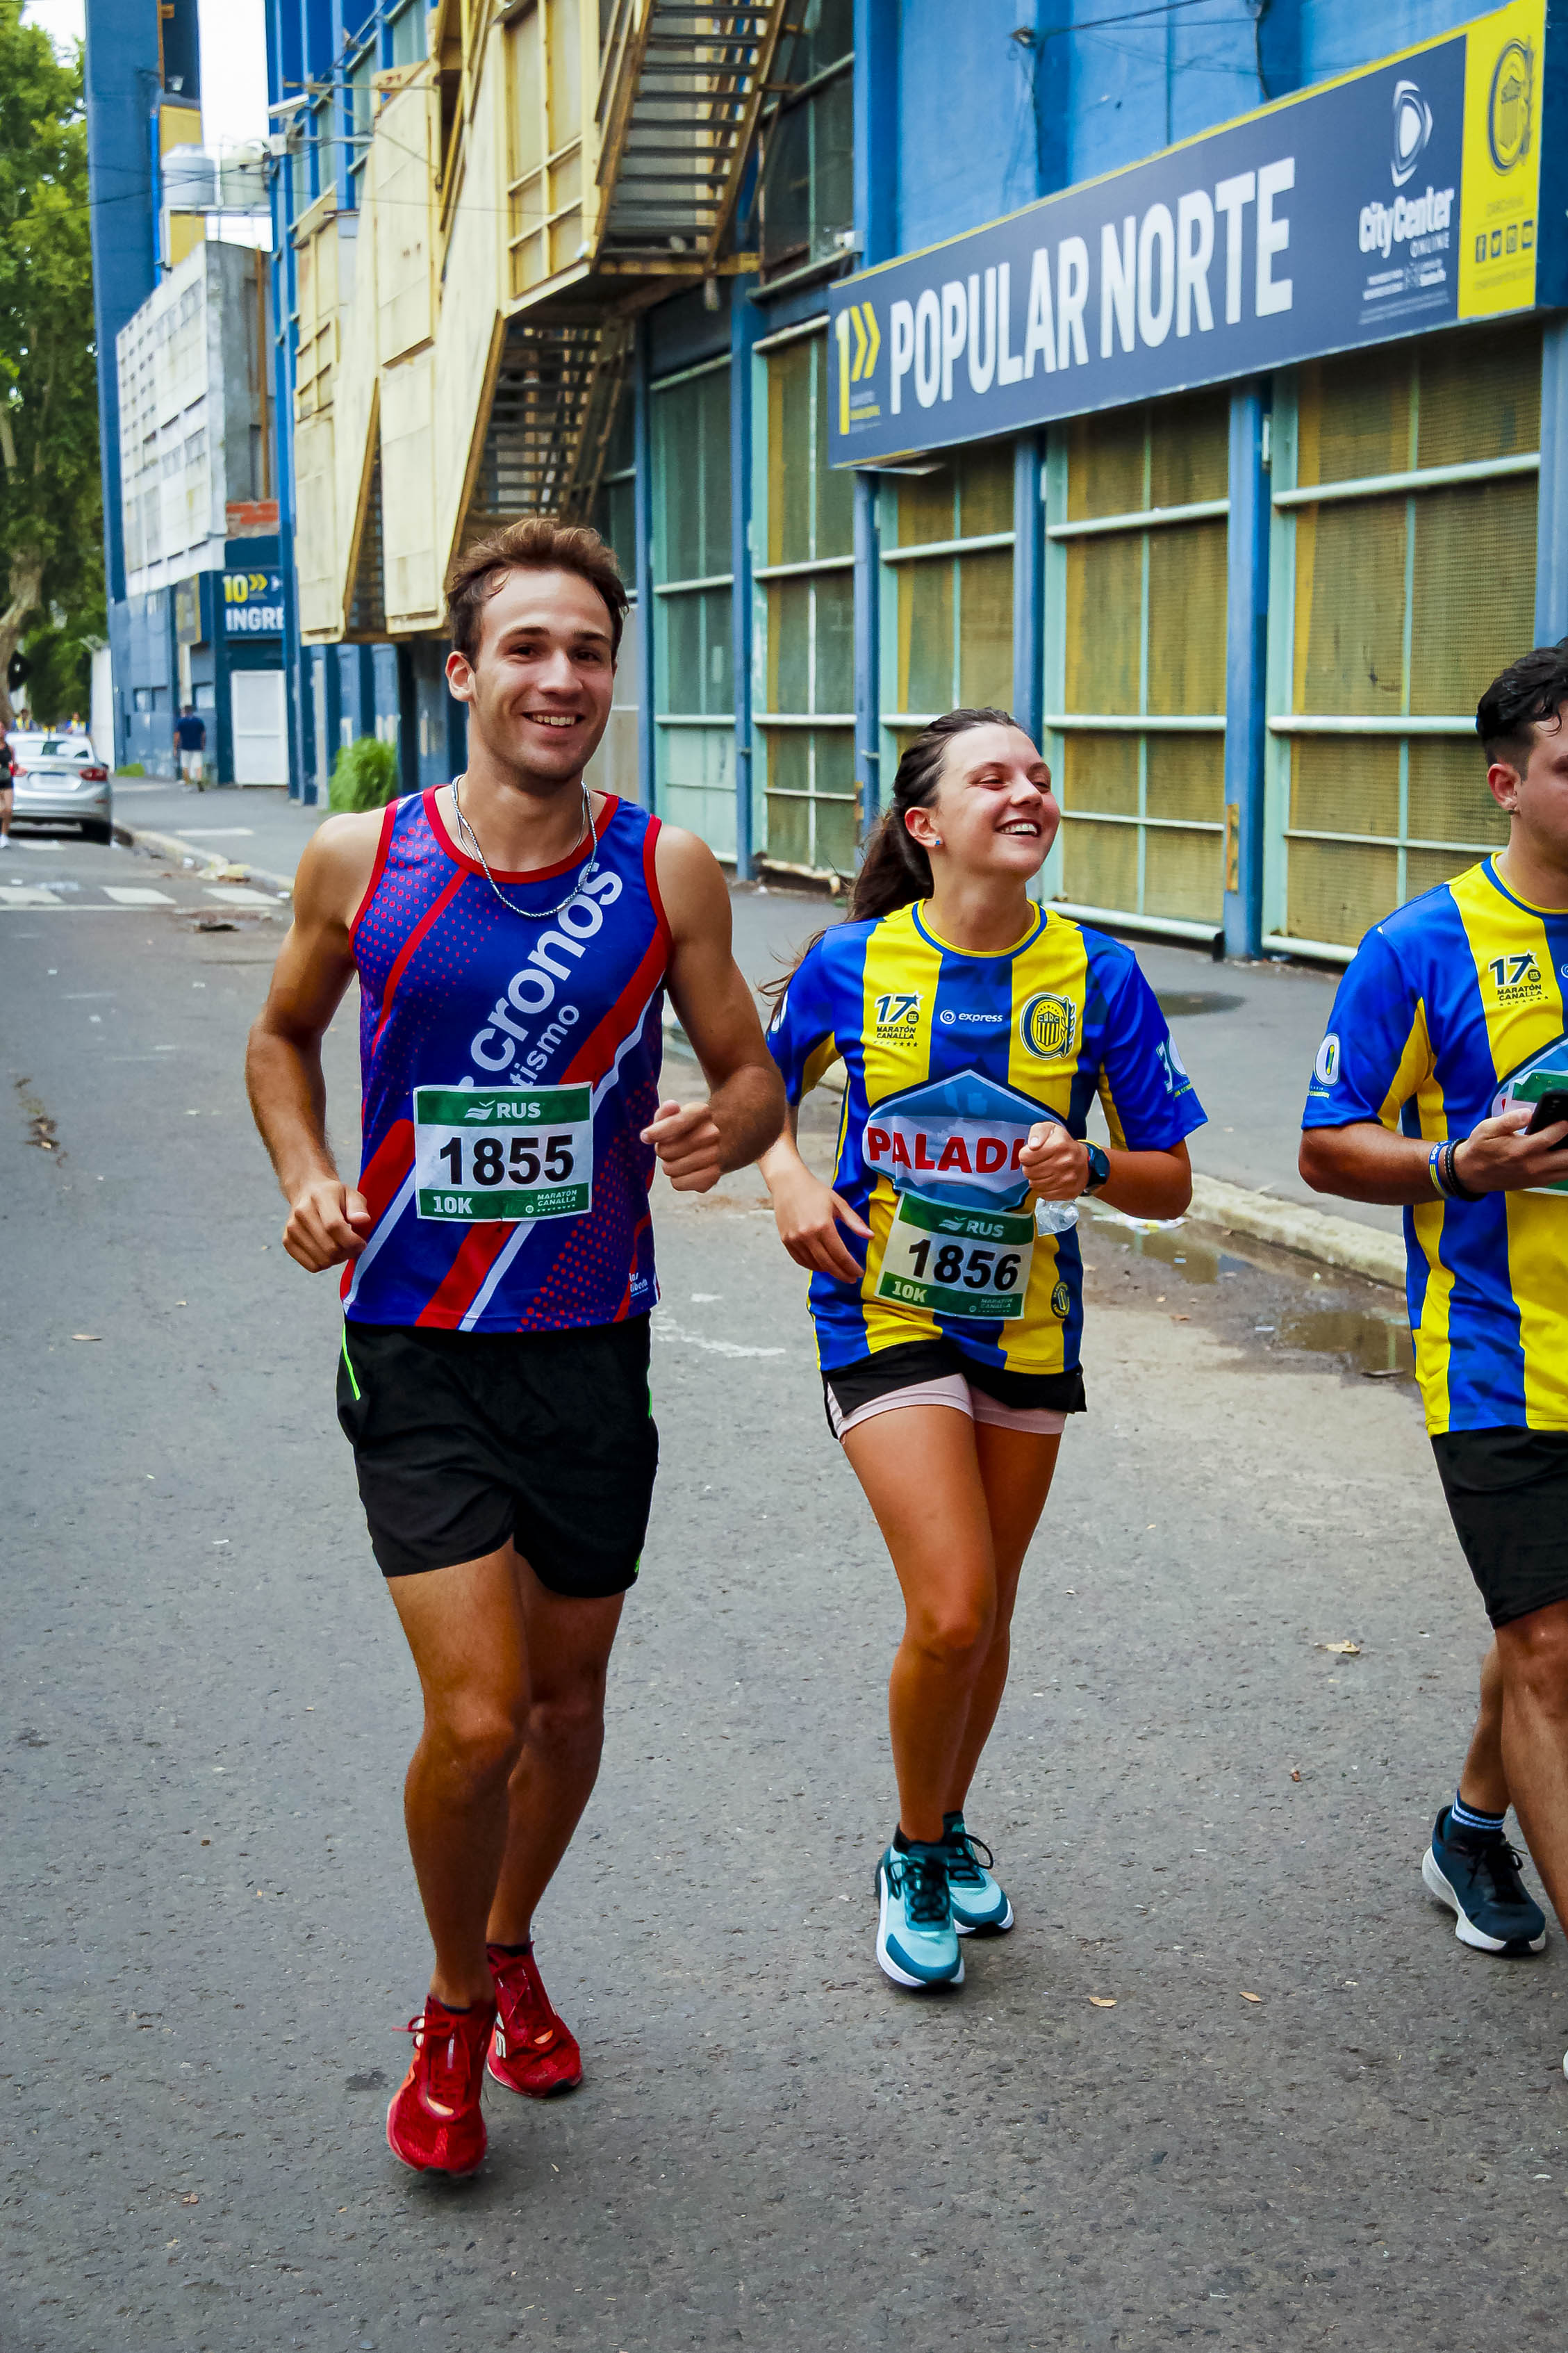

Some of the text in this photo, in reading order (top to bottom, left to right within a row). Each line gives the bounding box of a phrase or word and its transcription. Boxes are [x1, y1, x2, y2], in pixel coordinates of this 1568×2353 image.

[891, 236, 1089, 414] POPULAR
[1100, 156, 1295, 359] NORTE
[222, 574, 249, 603] 10
[470, 862, 622, 1072] cronos
[1488, 951, 1538, 987] 17
[1497, 984, 1542, 995] MARATÓN
[1499, 991, 1542, 1001] CANALLA
[875, 992, 922, 1025] 17
[959, 1012, 1003, 1023] express
[877, 1024, 916, 1033] MARATÓN
[496, 1102, 541, 1118] RUS
[440, 1134, 574, 1186] 1855
[433, 1195, 472, 1214] 10K
[537, 1189, 577, 1201] MARATÓN
[538, 1196, 576, 1206] CANALLA
[966, 1220, 1005, 1238] RUS
[909, 1238, 1022, 1290] 1856
[892, 1281, 927, 1303] 10K
